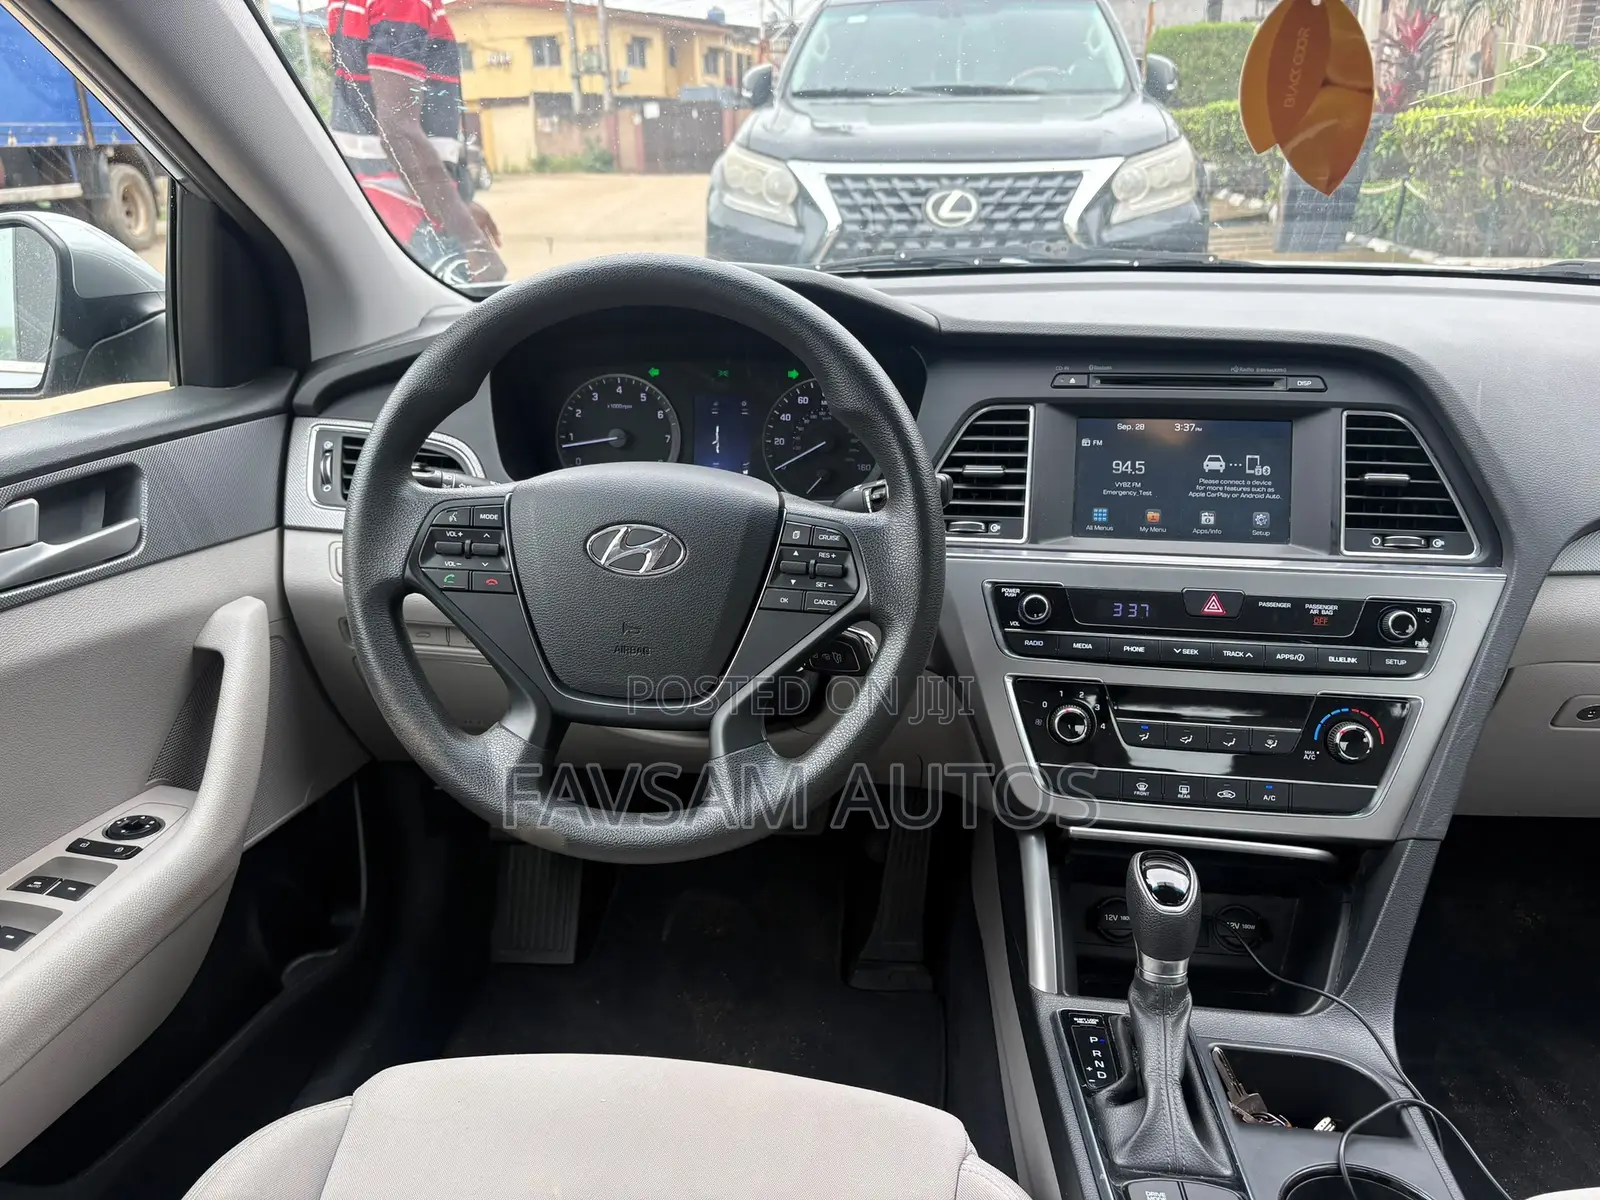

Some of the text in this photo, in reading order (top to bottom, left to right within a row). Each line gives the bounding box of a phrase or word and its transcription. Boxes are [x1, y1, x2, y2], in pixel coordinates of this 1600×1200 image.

[616, 386, 622, 394] 4
[592, 392, 598, 401] 3
[640, 393, 646, 402] 5
[576, 409, 582, 418] 2
[657, 411, 664, 419] 6
[1117, 423, 1134, 431] Sep.
[664, 435, 670, 443] 7
[1112, 460, 1145, 474] 94.5
[613, 645, 650, 655] AIRBAG
